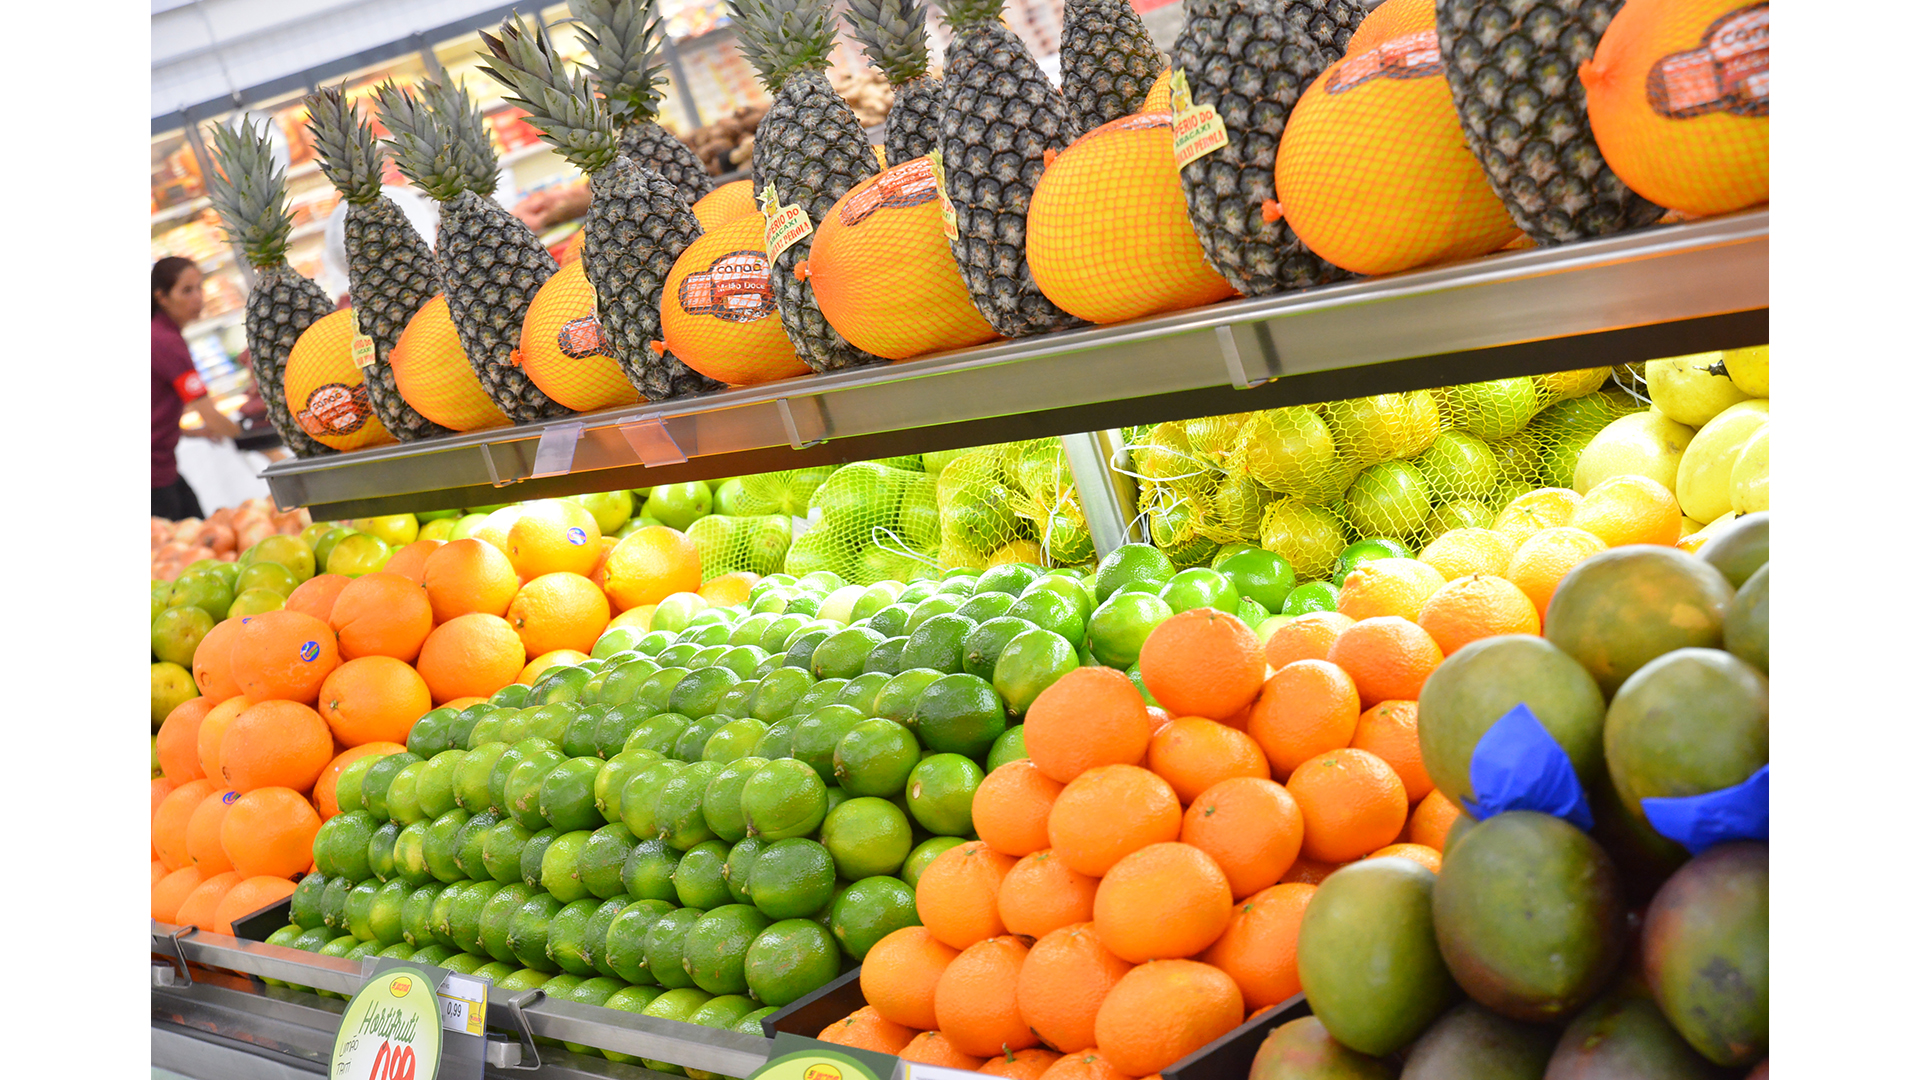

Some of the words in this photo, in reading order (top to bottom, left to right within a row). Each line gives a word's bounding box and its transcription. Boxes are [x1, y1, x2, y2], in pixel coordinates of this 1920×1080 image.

[1199, 110, 1213, 123] DO
[786, 207, 800, 220] DO
[446, 1001, 462, 1018] 0,99
